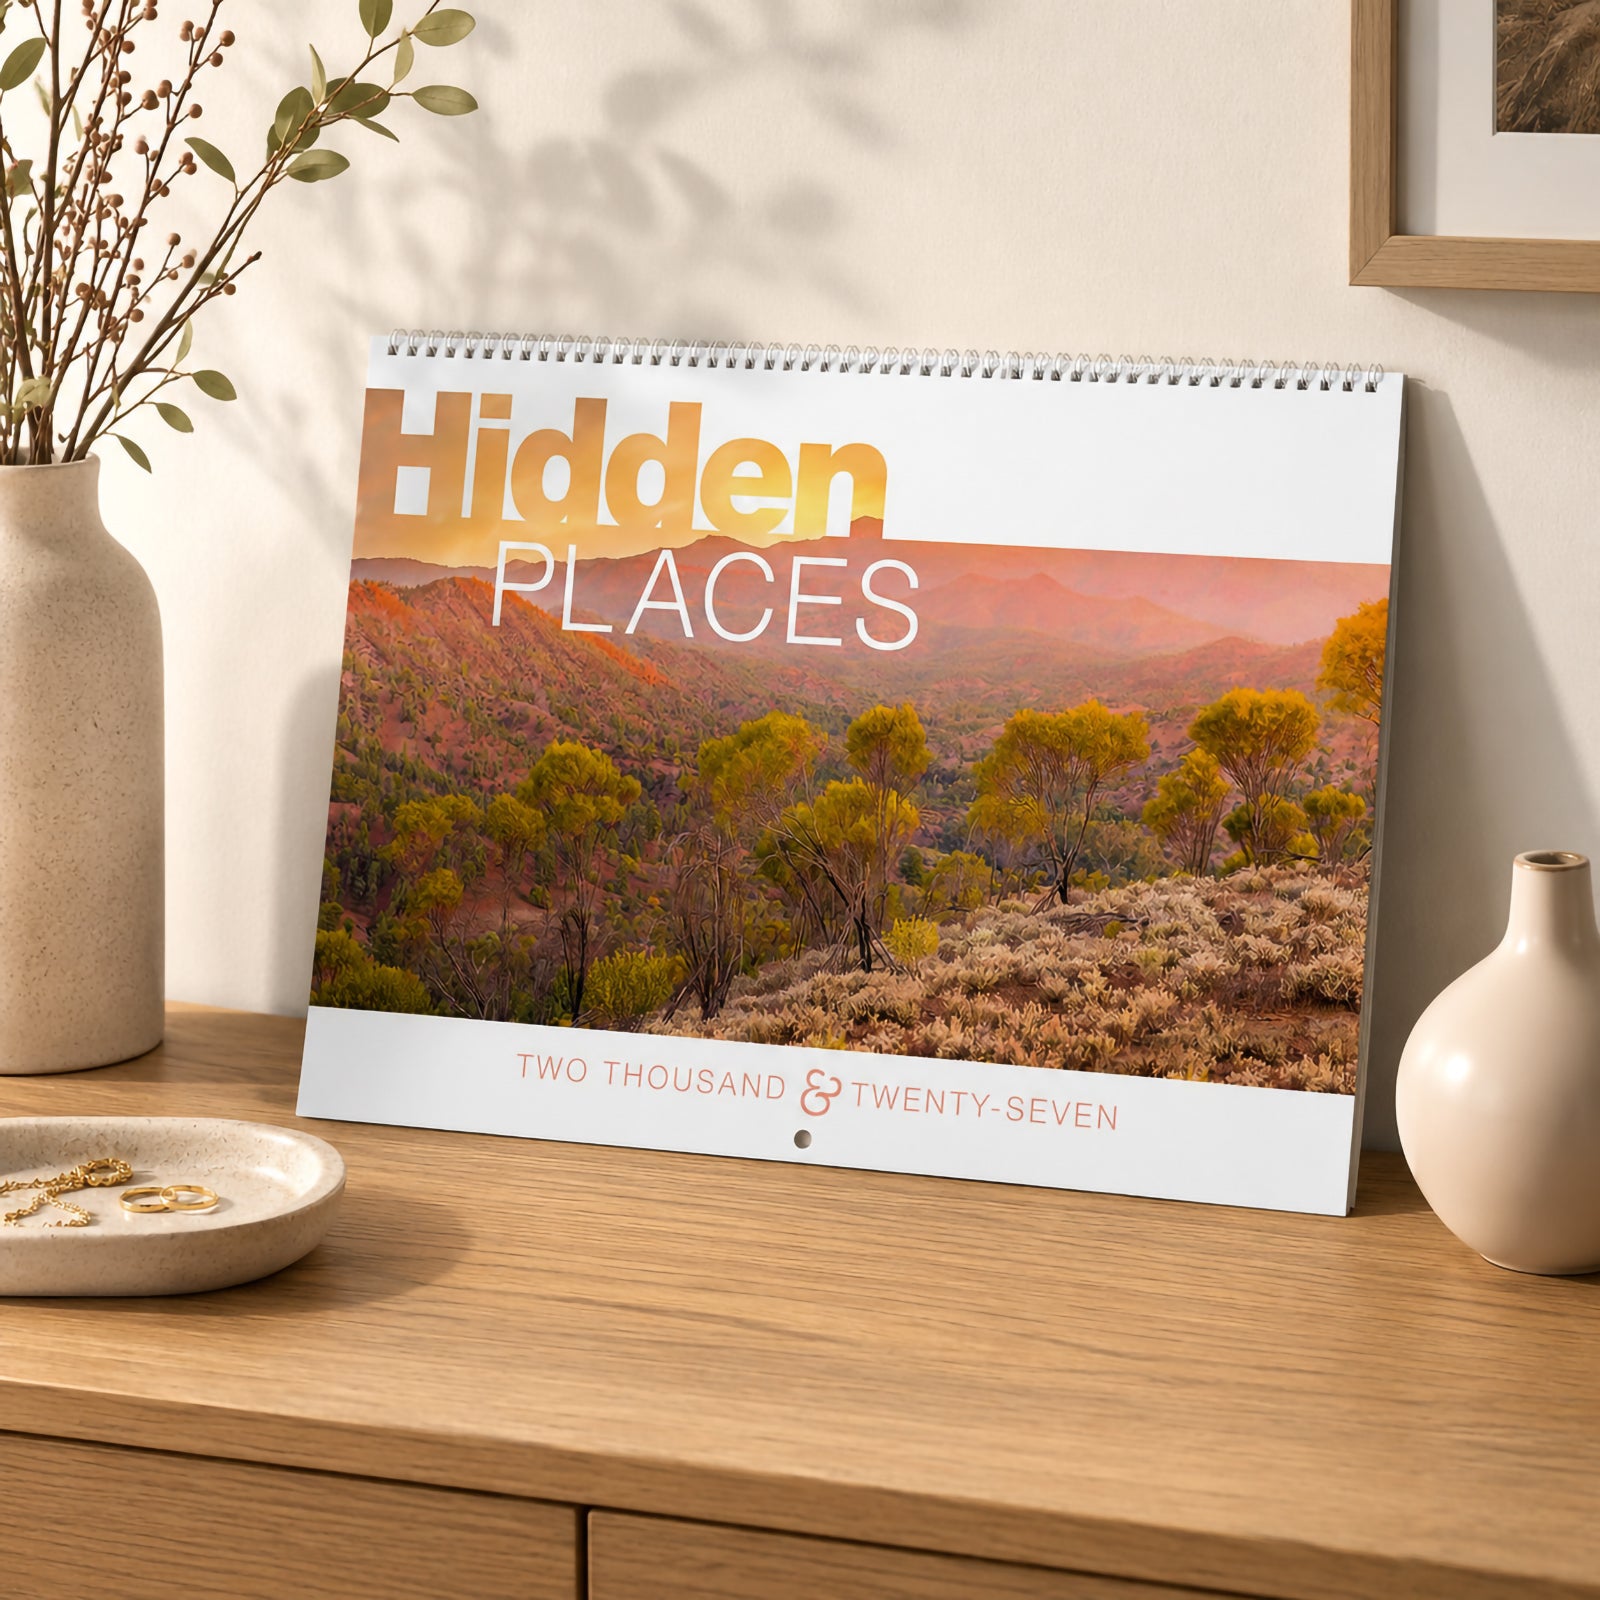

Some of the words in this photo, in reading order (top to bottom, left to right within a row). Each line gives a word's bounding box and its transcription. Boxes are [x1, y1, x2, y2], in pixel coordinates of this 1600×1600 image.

[357, 388, 888, 540] Hidden
[492, 540, 919, 651] PLACES
[517, 1053, 587, 1083] TWO
[604, 1060, 784, 1099] THOUSAND
[800, 1068, 842, 1117] &
[852, 1081, 1117, 1130] TWENTY-SEVEN
